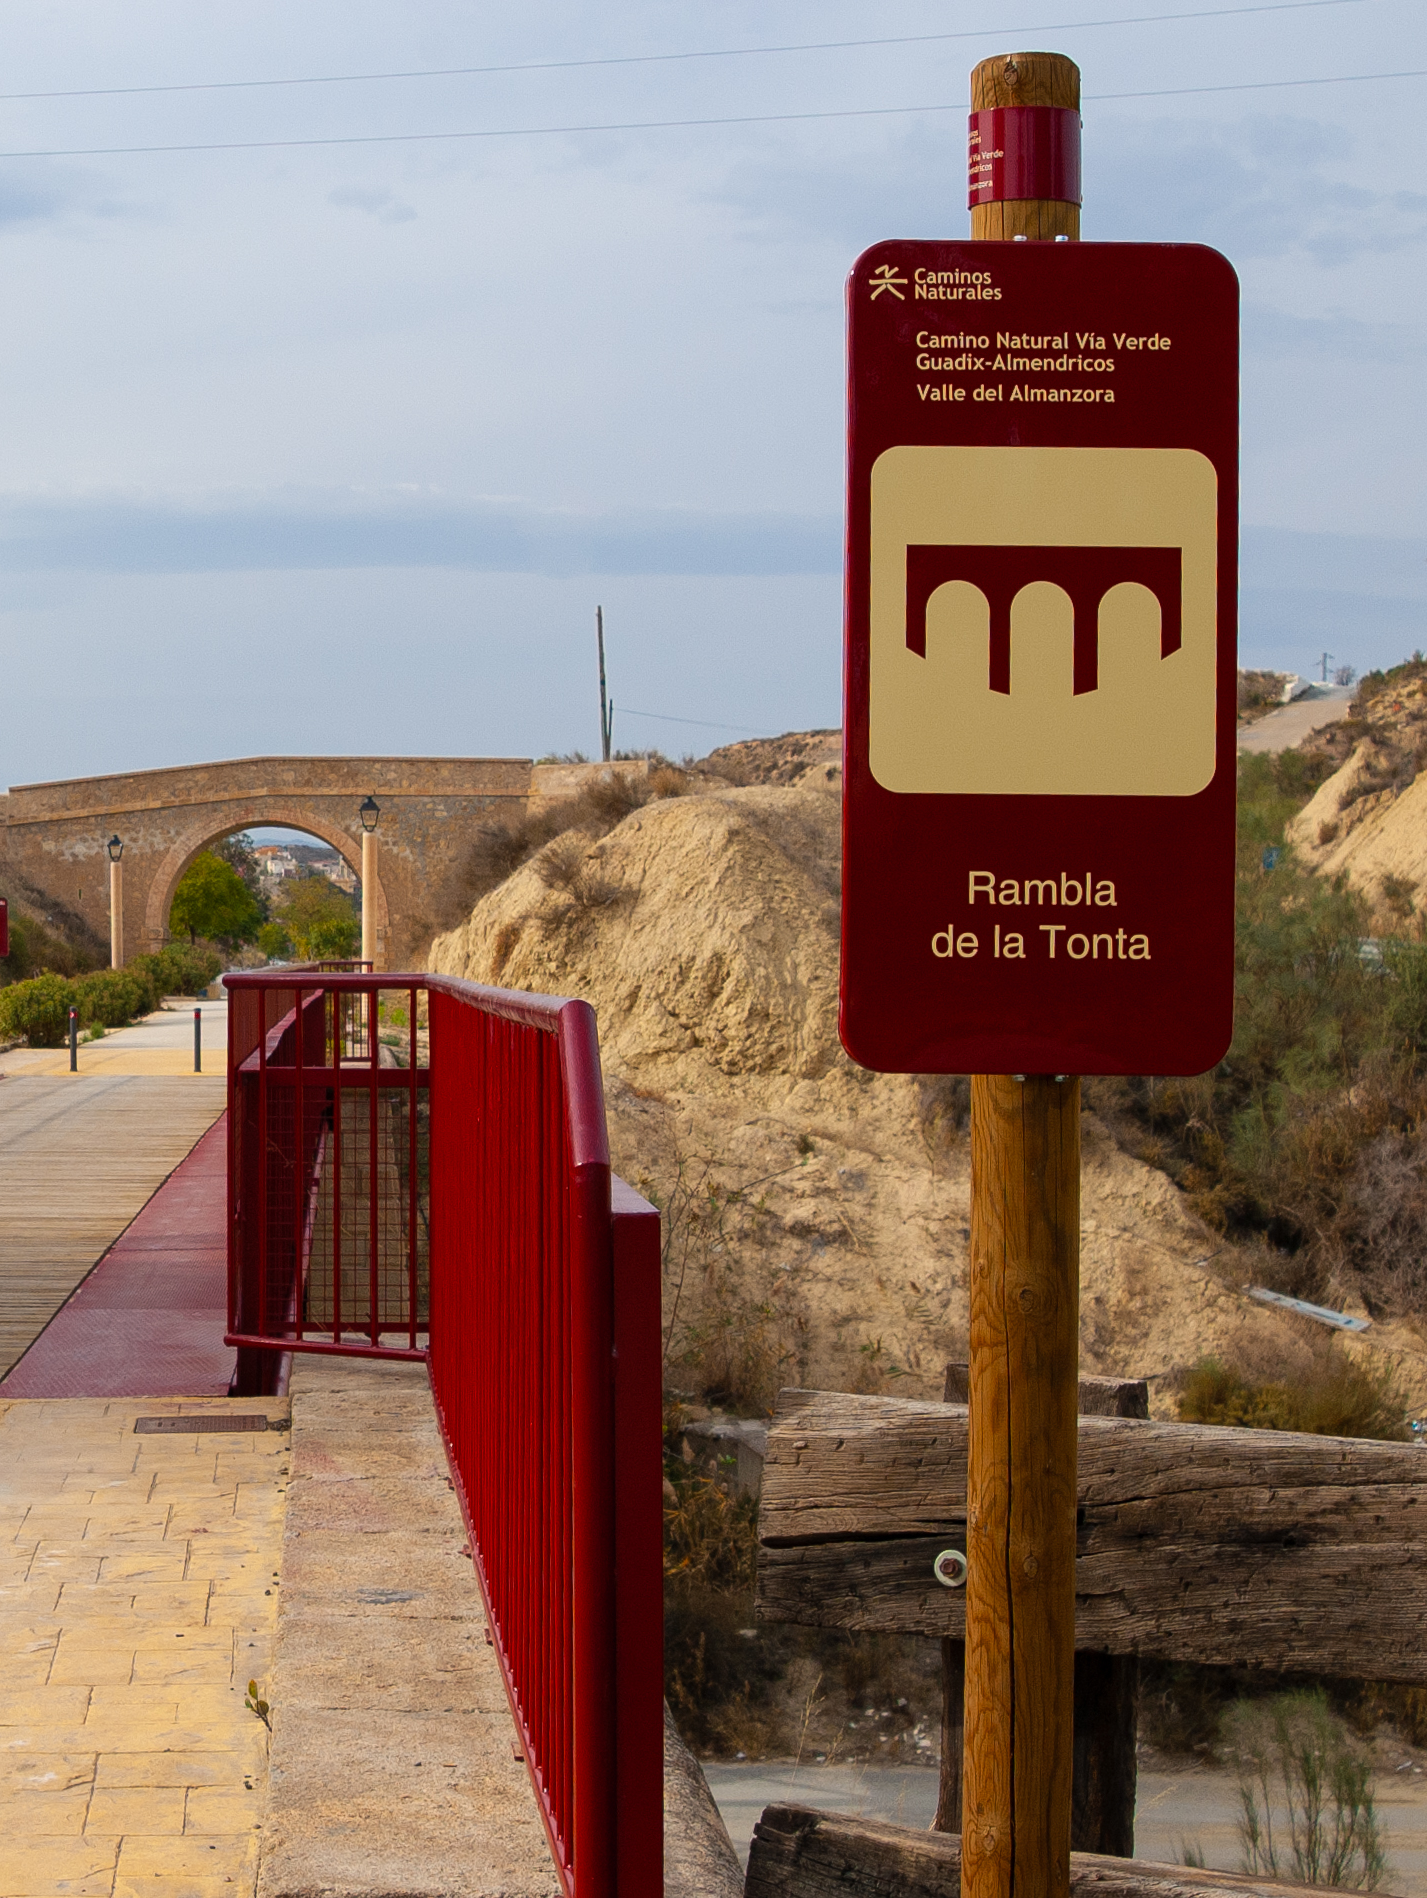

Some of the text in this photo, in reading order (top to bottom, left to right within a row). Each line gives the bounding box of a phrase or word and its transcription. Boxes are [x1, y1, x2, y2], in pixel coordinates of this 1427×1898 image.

[914, 267, 992, 285] Caminos
[914, 284, 1003, 301] Naturales
[916, 331, 1172, 352] Camino Natural Vía Verde
[916, 353, 1115, 373] Guadix-Almendricos
[916, 383, 1116, 404] Valle del Almanzora
[968, 870, 1118, 907] Rambla
[931, 923, 1152, 960] de la Tonta
